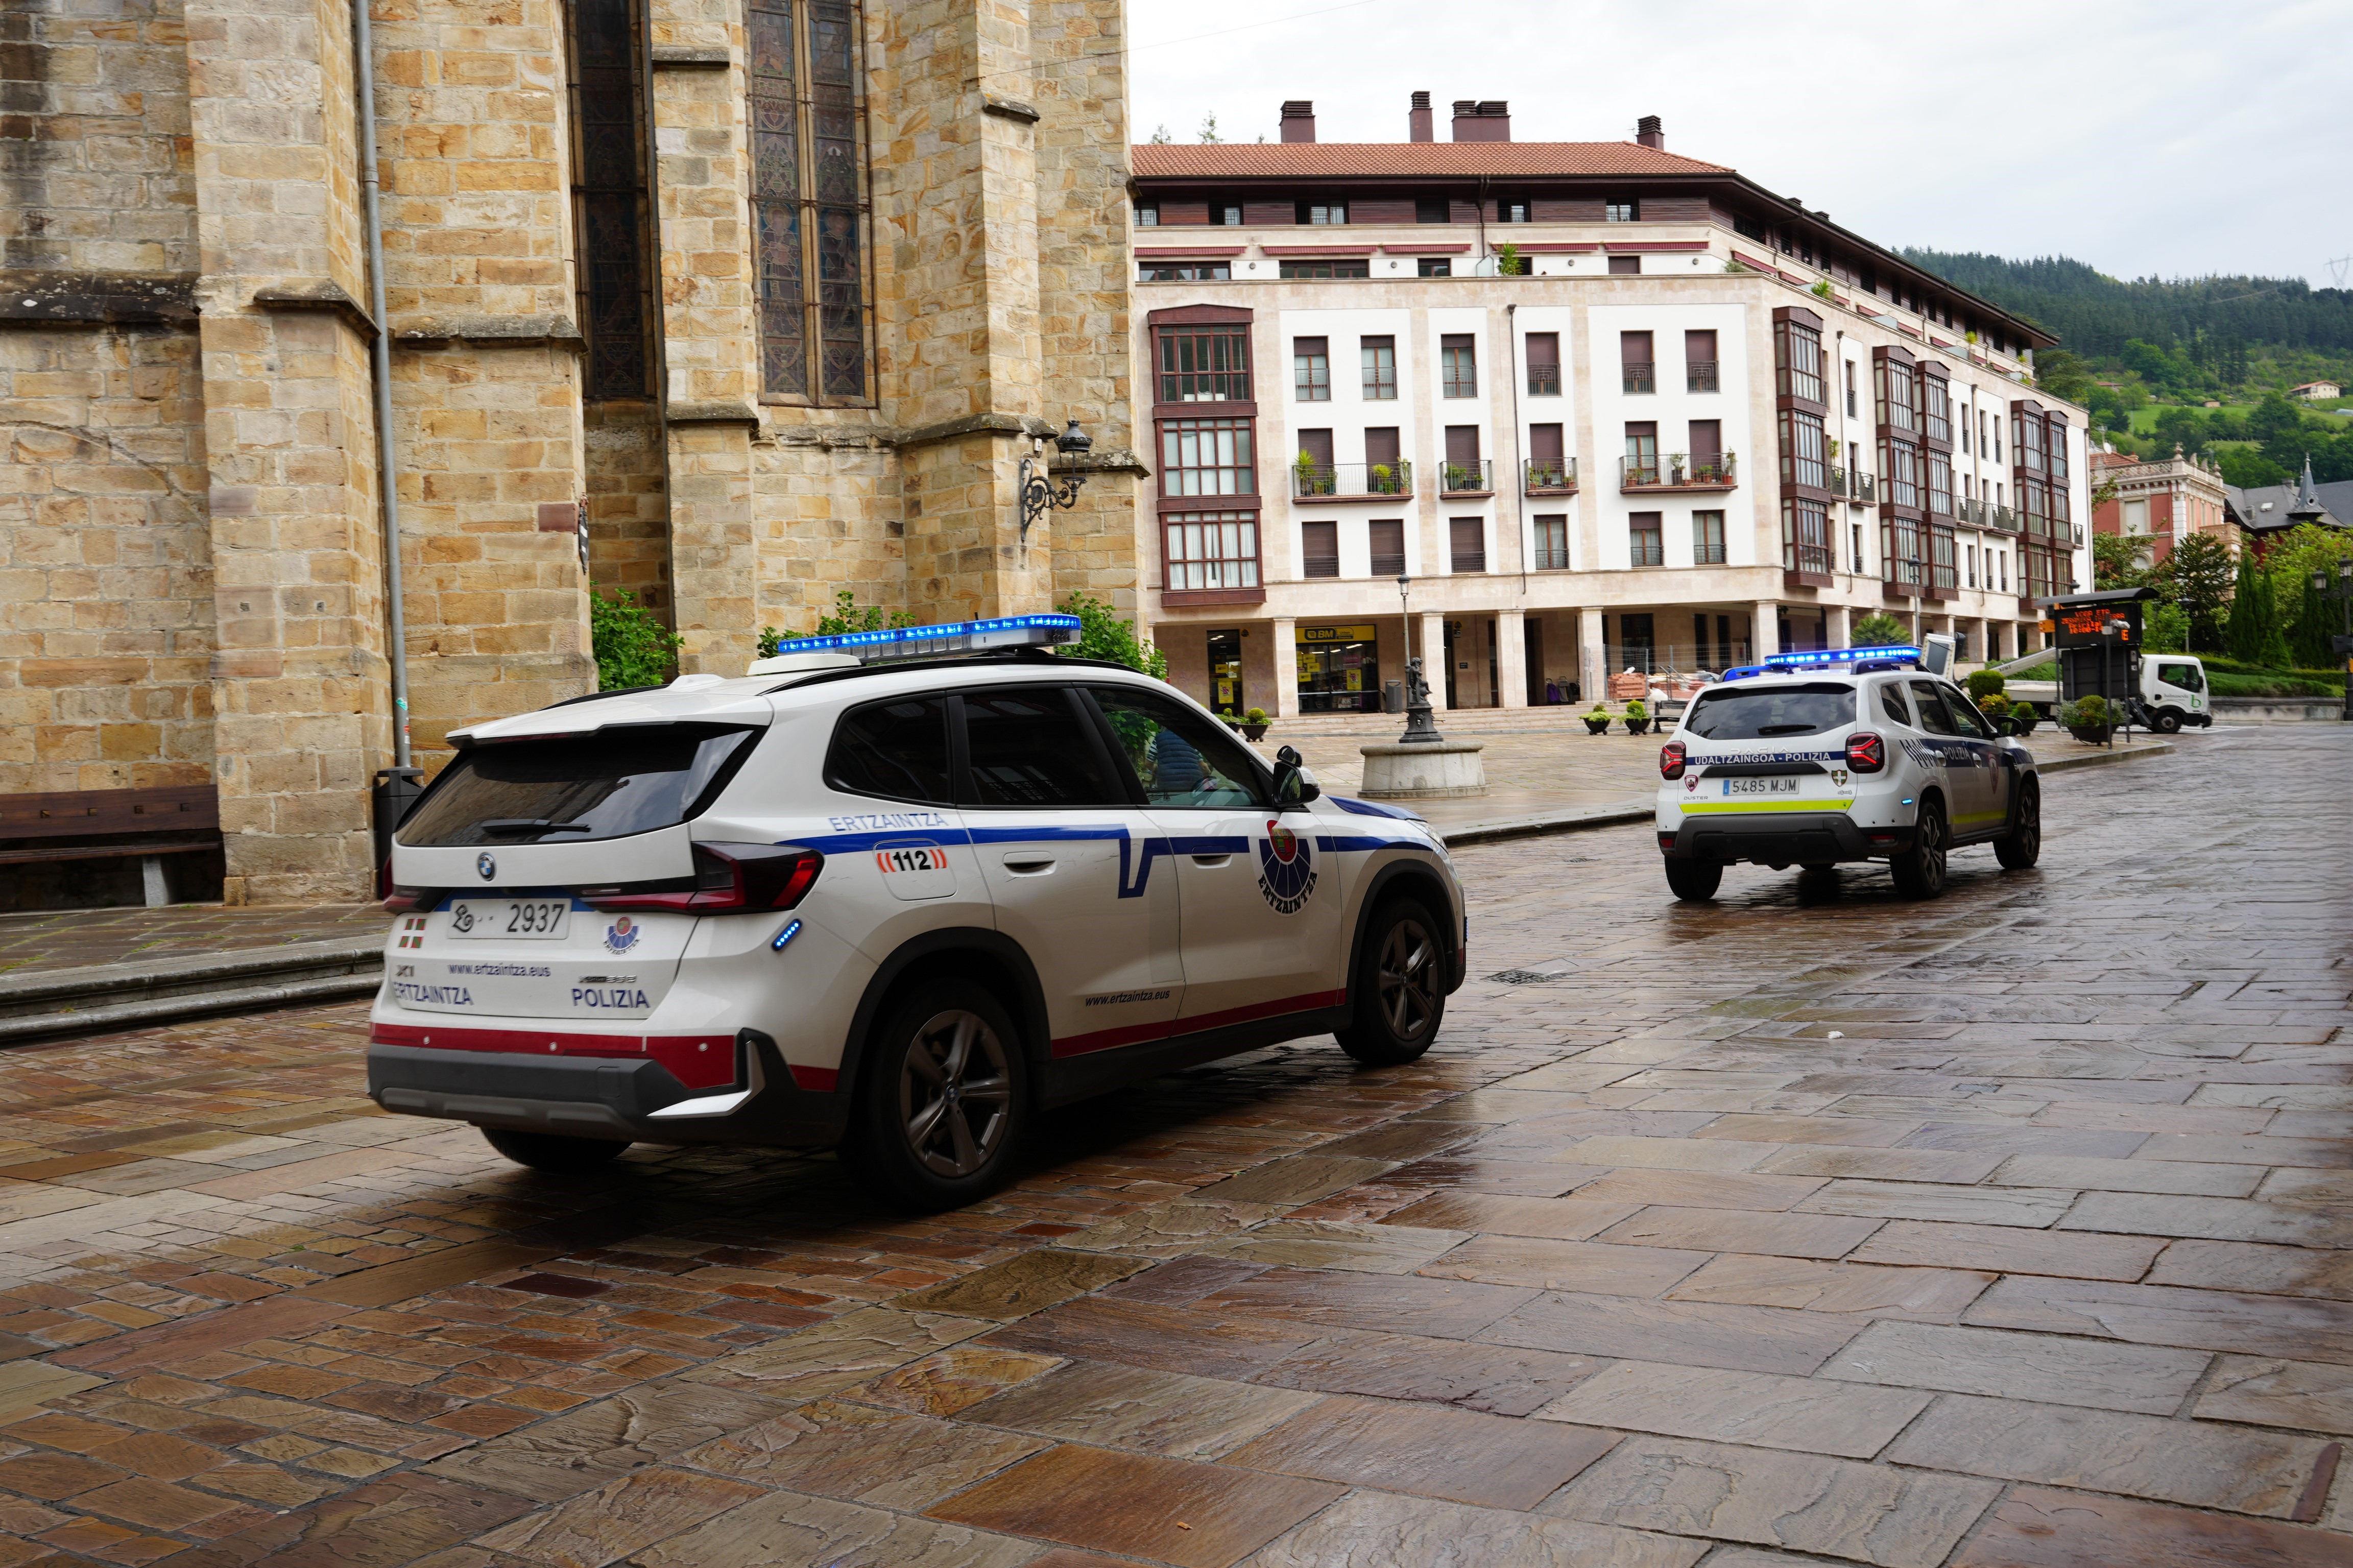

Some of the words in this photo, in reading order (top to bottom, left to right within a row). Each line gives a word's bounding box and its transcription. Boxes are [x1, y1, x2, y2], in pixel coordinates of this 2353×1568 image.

[1317, 630, 1333, 638] BM
[1695, 754, 1776, 765] UDALTZAINGOA
[1787, 752, 1831, 762] POLIZIA
[1943, 746, 1971, 760] POLIZIA
[1733, 780, 1765, 792] 5485
[1771, 779, 1796, 791] MJM
[828, 813, 949, 832] ERTZAINTZA
[1258, 872, 1317, 914] ERTZAINTZA
[507, 904, 565, 933] 2937
[395, 964, 415, 977] X1
[447, 962, 551, 977] www.ertzaintza.eus
[393, 981, 474, 1005] ERTZAINTZA
[571, 988, 651, 1008] POLIZIA
[1086, 990, 1170, 1007] www.ertzaintza.eus
